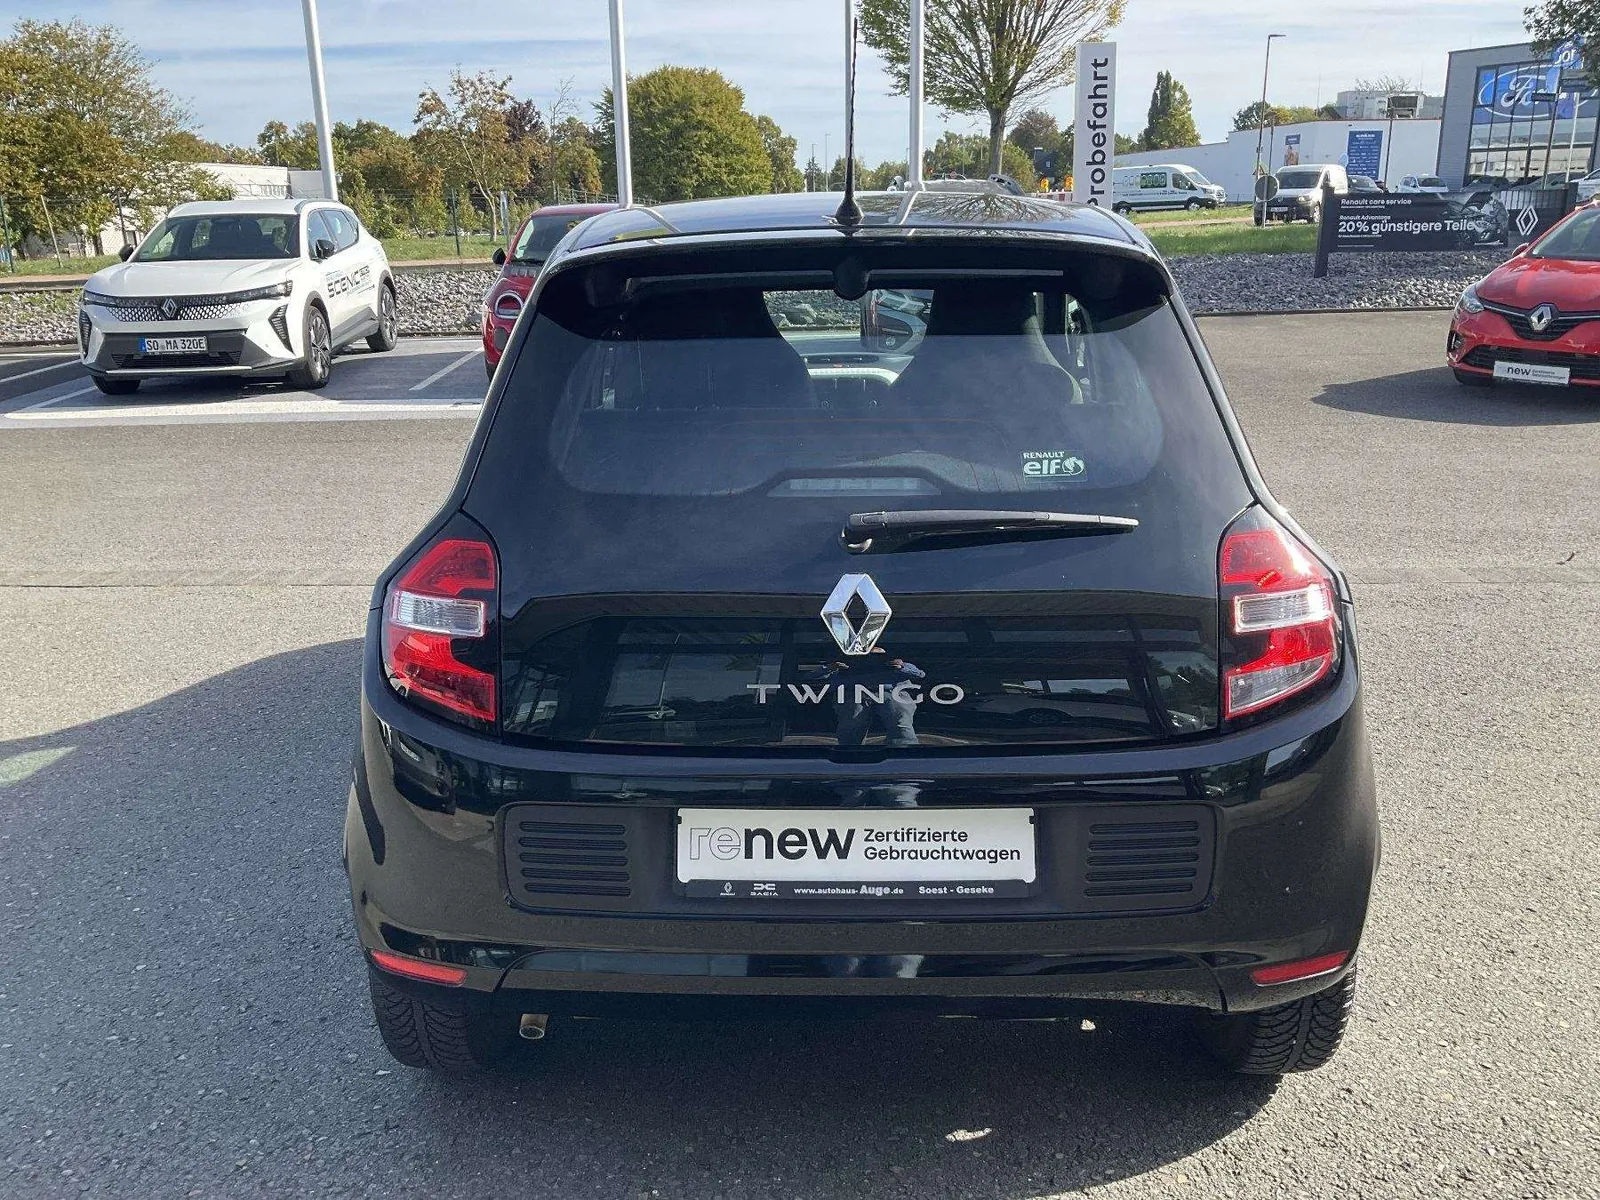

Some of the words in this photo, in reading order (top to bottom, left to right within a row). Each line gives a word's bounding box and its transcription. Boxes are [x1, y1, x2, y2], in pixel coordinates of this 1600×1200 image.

[1338, 220, 1370, 233] 20%
[1371, 219, 1442, 234] günstigere
[1445, 219, 1475, 231] Teile
[146, 340, 159, 350] SO
[165, 340, 179, 350] MA
[180, 338, 205, 349] 320E
[1023, 451, 1064, 459] RENAULT
[1023, 459, 1061, 475] elf
[746, 683, 965, 705] TWINGO
[863, 827, 968, 843] Zertifizierte
[689, 826, 856, 861] renew
[863, 846, 1021, 864] Gebrauchtwagen
[918, 886, 948, 894] Soest
[956, 886, 994, 894] Geseke
